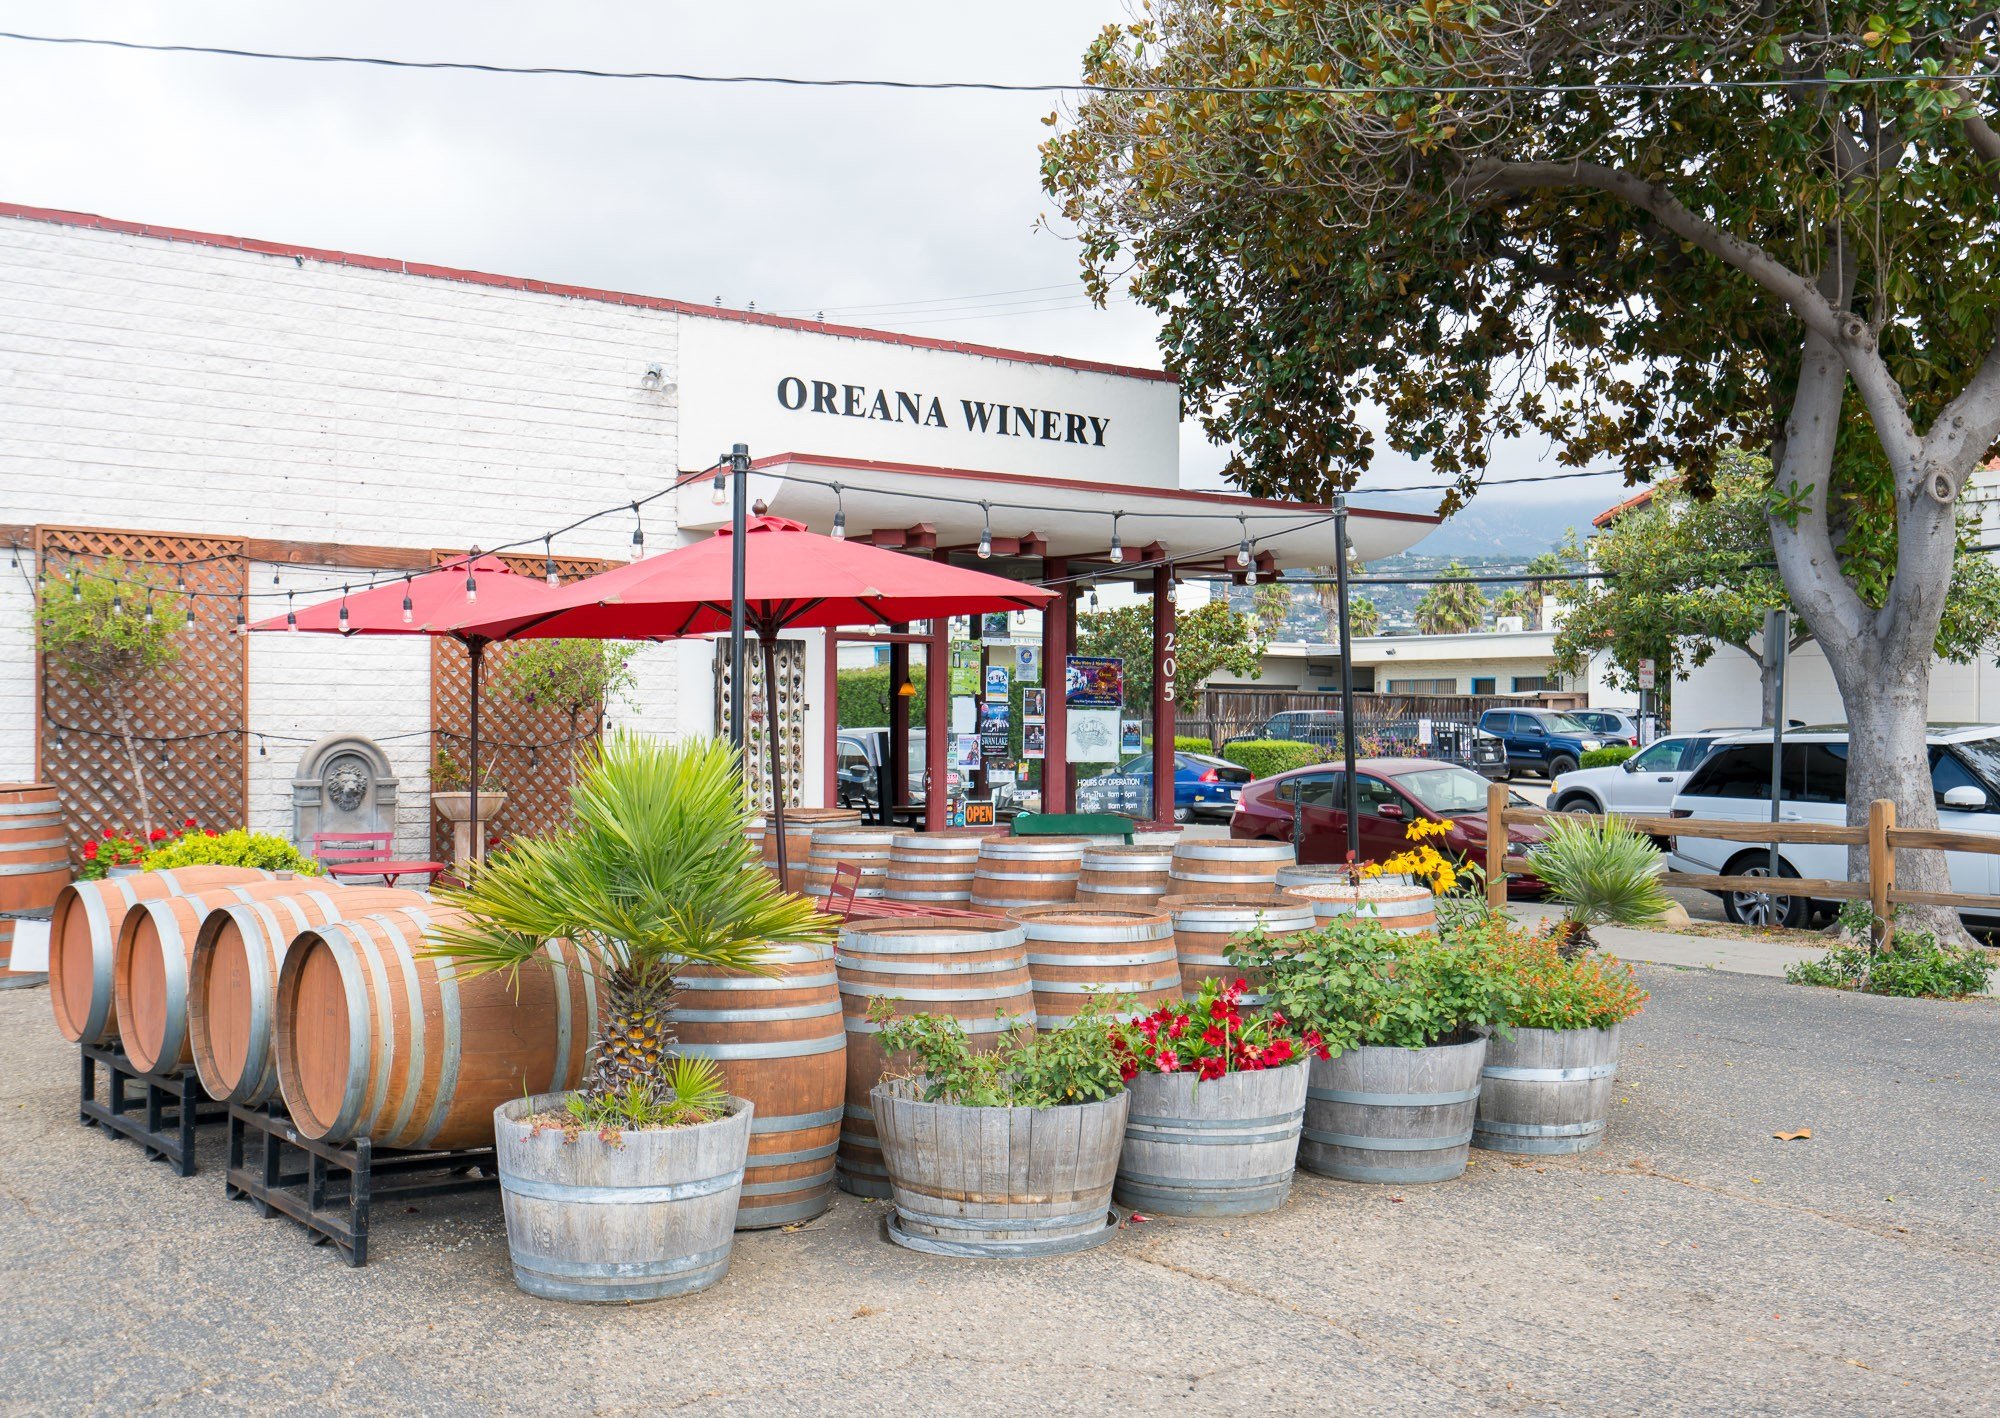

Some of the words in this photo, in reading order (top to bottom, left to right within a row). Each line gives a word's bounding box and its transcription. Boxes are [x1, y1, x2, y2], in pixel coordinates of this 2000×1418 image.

[777, 376, 948, 428] OREANA
[960, 399, 1111, 447] WINERY
[1163, 632, 1176, 702] 205
[996, 736, 1008, 746] LAKE
[1077, 778, 1097, 787] HOURS
[1098, 778, 1107, 786] OF
[1108, 777, 1140, 786] OPERATION
[1124, 791, 1137, 799] 6pm
[966, 805, 993, 823] OPEN
